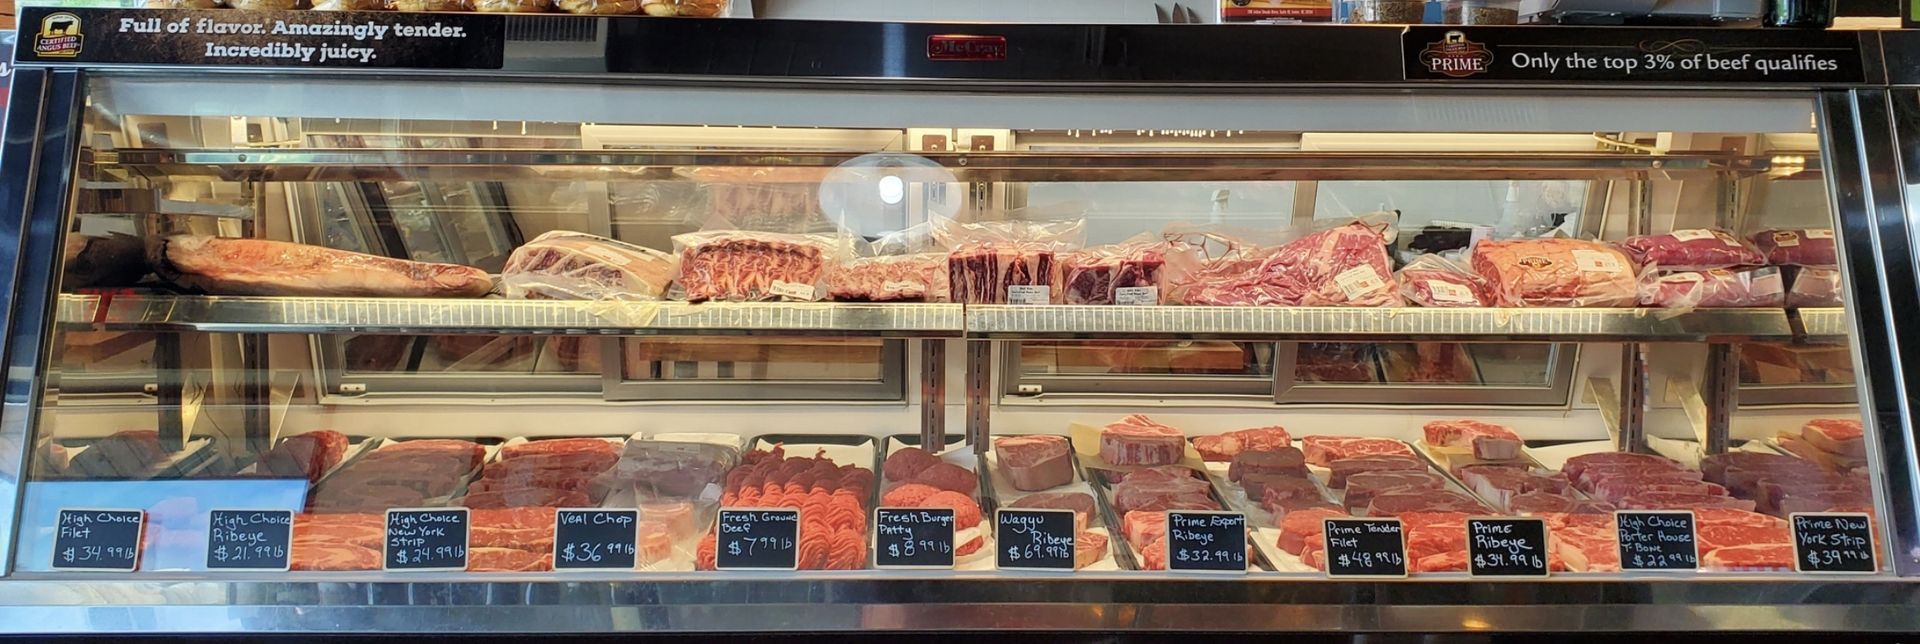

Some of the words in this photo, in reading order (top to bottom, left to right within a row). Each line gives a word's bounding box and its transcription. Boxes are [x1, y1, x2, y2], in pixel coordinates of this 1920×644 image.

[118, 17, 162, 33] Full
[166, 17, 191, 34] of
[196, 18, 266, 34] flavor.
[271, 20, 389, 41] Amazingly
[393, 22, 467, 38] tender.
[39, 36, 77, 45] CERTIFIED
[204, 42, 316, 62] Incredibly
[319, 43, 377, 62] juicy.
[1431, 58, 1484, 71] PRIME
[1511, 52, 1560, 74] Only
[1565, 52, 1598, 69] the
[1603, 55, 1638, 74] top
[1644, 54, 1675, 70] 3%
[1680, 53, 1704, 70] of
[1706, 53, 1752, 70] beef
[1754, 54, 1838, 75] qualifies
[62, 513, 93, 527] High
[97, 513, 140, 523] Choice
[213, 512, 248, 530] High
[250, 513, 290, 524] Choice
[390, 512, 418, 529] High
[420, 513, 460, 523] Choice
[593, 513, 632, 528] Chop
[722, 512, 758, 522] Fresh
[879, 511, 919, 523] Fresh
[920, 512, 954, 526] Burger
[1000, 513, 1044, 533] Wagyu
[1172, 514, 1206, 526] Prime
[1210, 515, 1244, 529] Export
[1620, 515, 1645, 530] High
[1647, 516, 1687, 528] Choice
[1795, 516, 1833, 530] Prime
[1835, 518, 1866, 530] New
[61, 527, 91, 539] Filet
[388, 528, 416, 536] New
[418, 526, 445, 536] York
[721, 523, 751, 533] Beef
[1328, 521, 1362, 537] Prime
[1619, 529, 1653, 542] Porter
[1657, 530, 1691, 542] House
[213, 528, 267, 546] Ribeye
[1030, 531, 1074, 551] Ribeye
[1172, 529, 1214, 546] Ribeye
[1330, 538, 1358, 548] Filet
[1475, 535, 1533, 554] Ribeye
[1799, 532, 1828, 546] York
[1830, 533, 1865, 549] Strip
